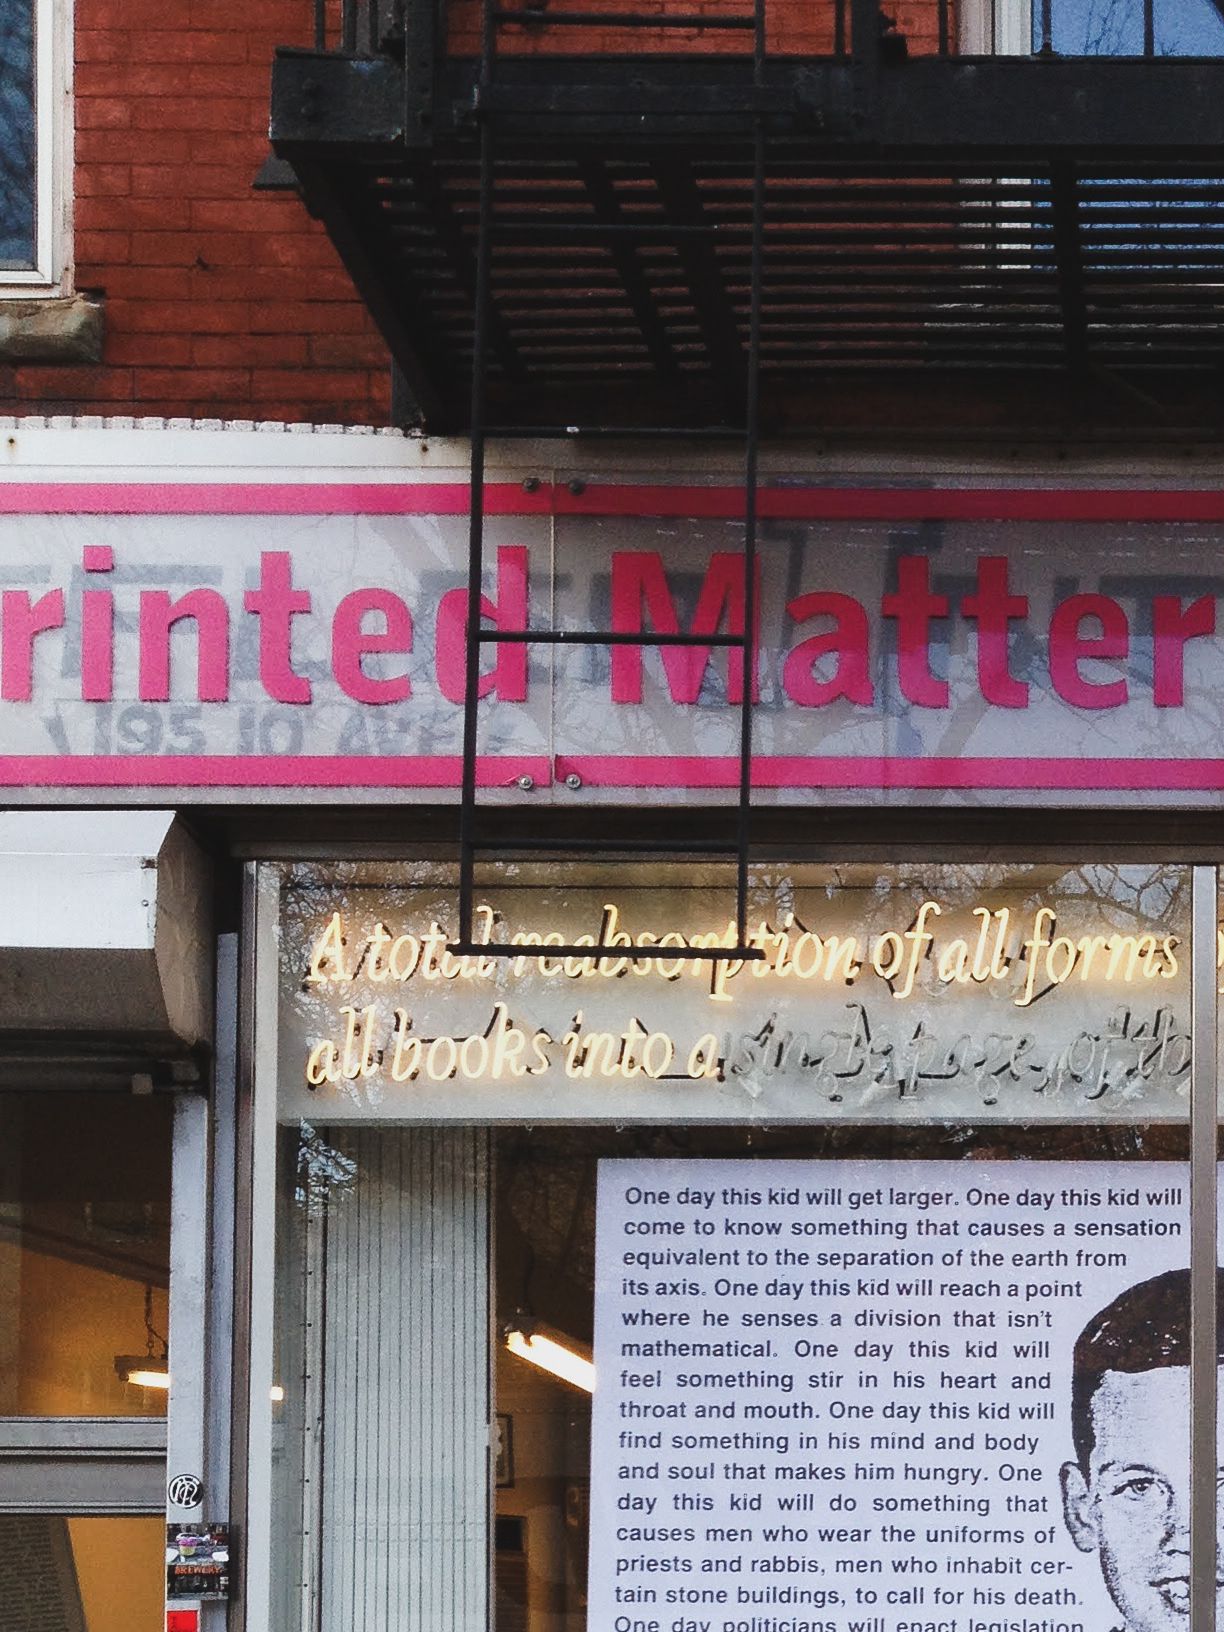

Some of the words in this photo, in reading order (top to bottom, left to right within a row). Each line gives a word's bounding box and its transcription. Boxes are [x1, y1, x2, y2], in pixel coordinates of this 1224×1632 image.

[307, 911, 353, 983] A
[873, 901, 941, 998] of
[939, 907, 1012, 984] all
[1015, 907, 1180, 1007] forms
[306, 1004, 380, 1086] all
[392, 1001, 553, 1082] books
[564, 1009, 675, 1079] into
[685, 1031, 721, 1081] a
[624, 1186, 671, 1206] One
[676, 1186, 716, 1210] day
[720, 1187, 763, 1206] this
[767, 1187, 801, 1206] kid
[805, 1187, 842, 1206] will
[847, 1188, 884, 1211] get
[888, 1186, 960, 1211] larger.
[966, 1187, 1011, 1207] One
[1015, 1188, 1056, 1212] day
[1059, 1187, 1102, 1207] this
[1107, 1187, 1140, 1207] kid
[1145, 1187, 1182, 1207] will
